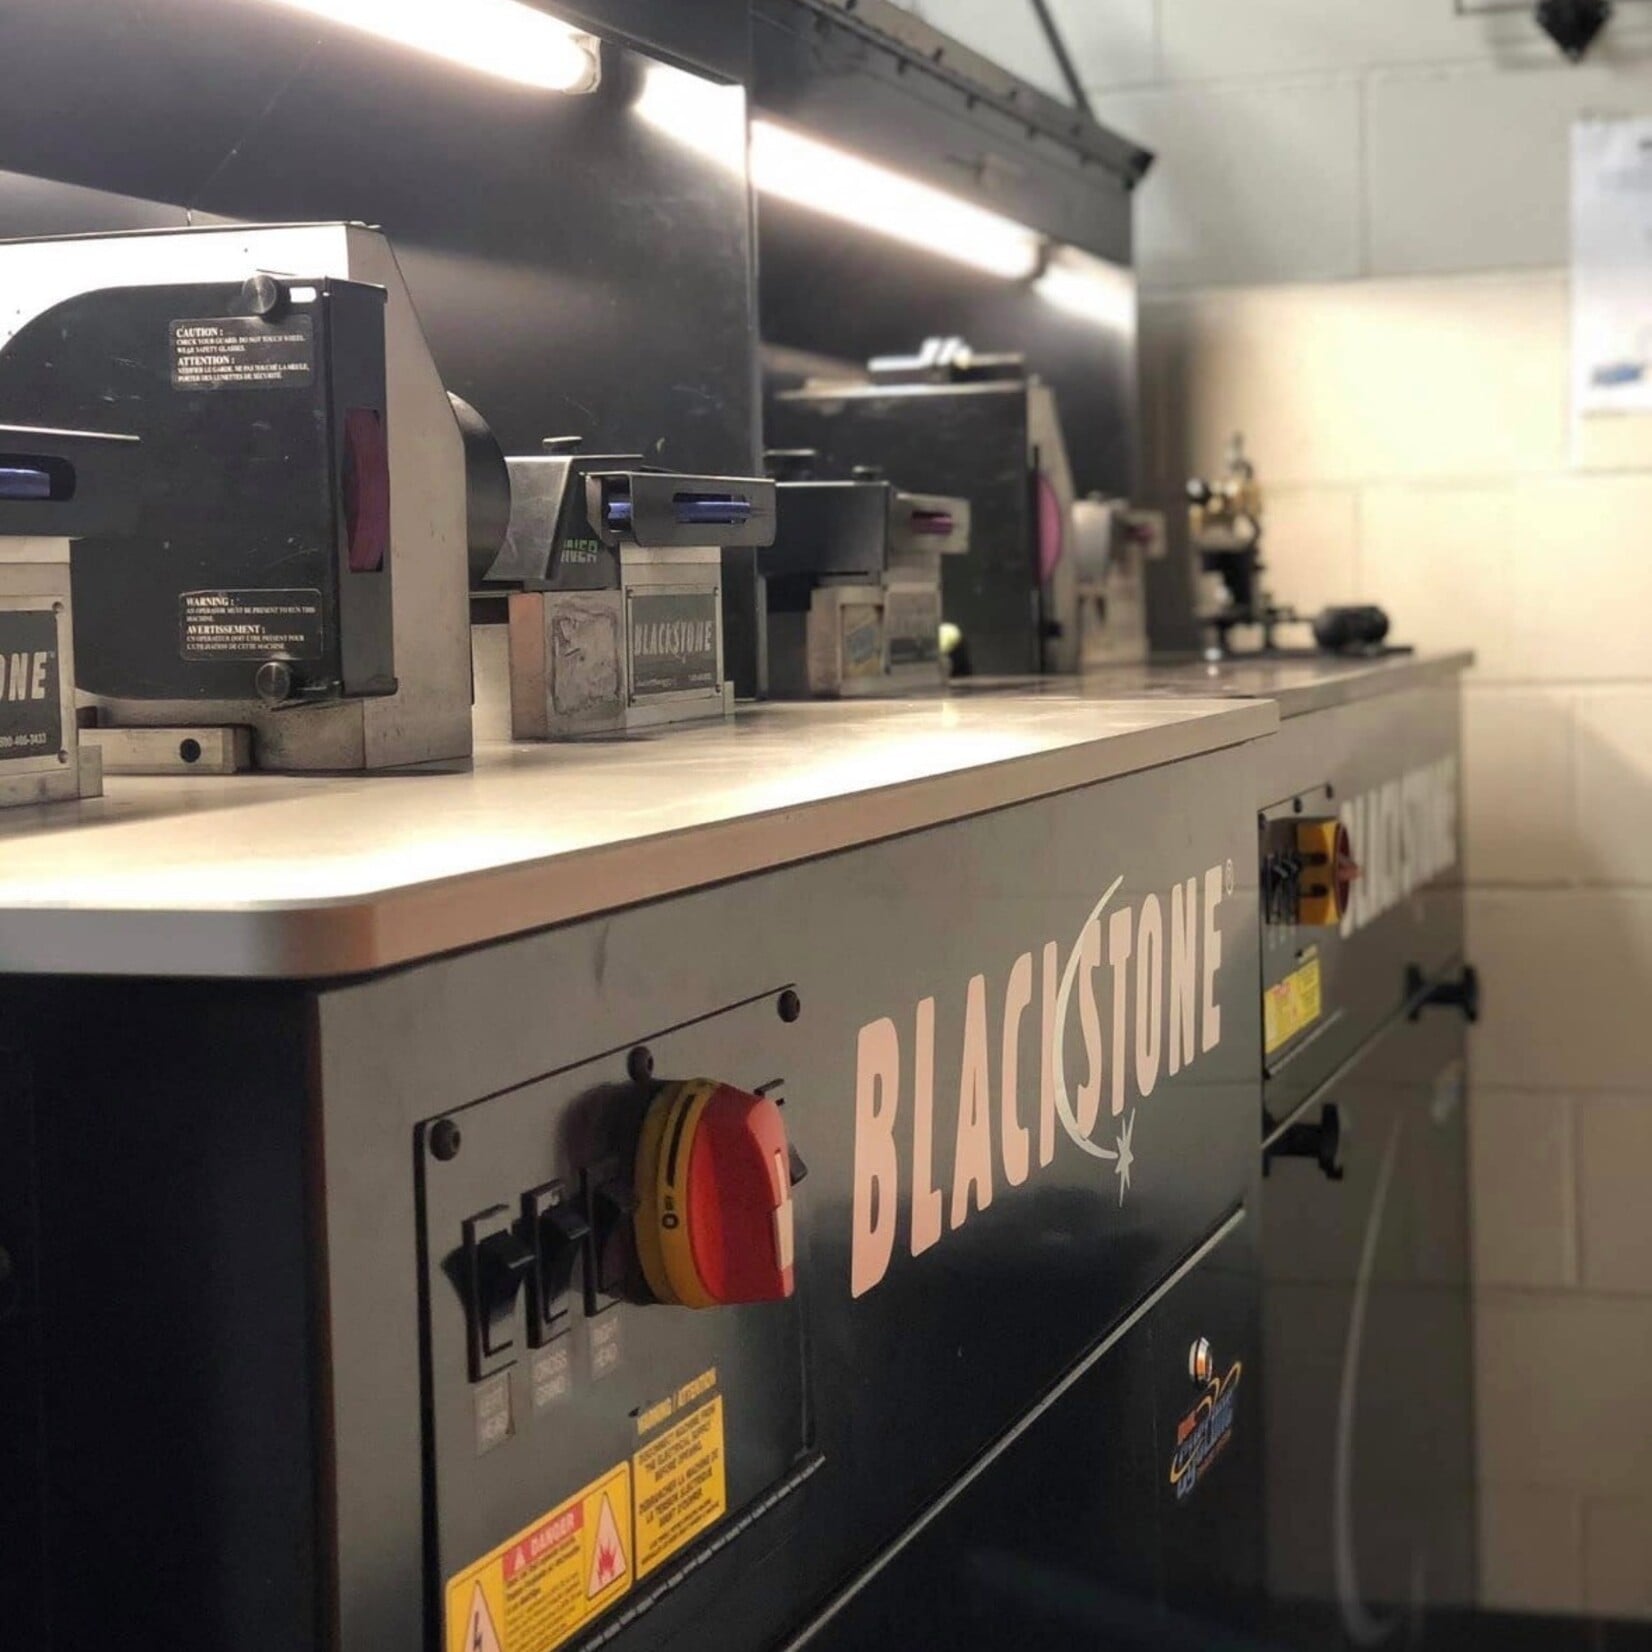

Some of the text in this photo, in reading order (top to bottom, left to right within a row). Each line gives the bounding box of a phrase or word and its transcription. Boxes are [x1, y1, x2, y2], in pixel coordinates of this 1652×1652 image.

[178, 356, 230, 366] ATTENTION
[186, 597, 229, 606] WARNING
[186, 625, 260, 635] AVERTISSEMENT
[634, 619, 713, 657] BLACKSTONE
